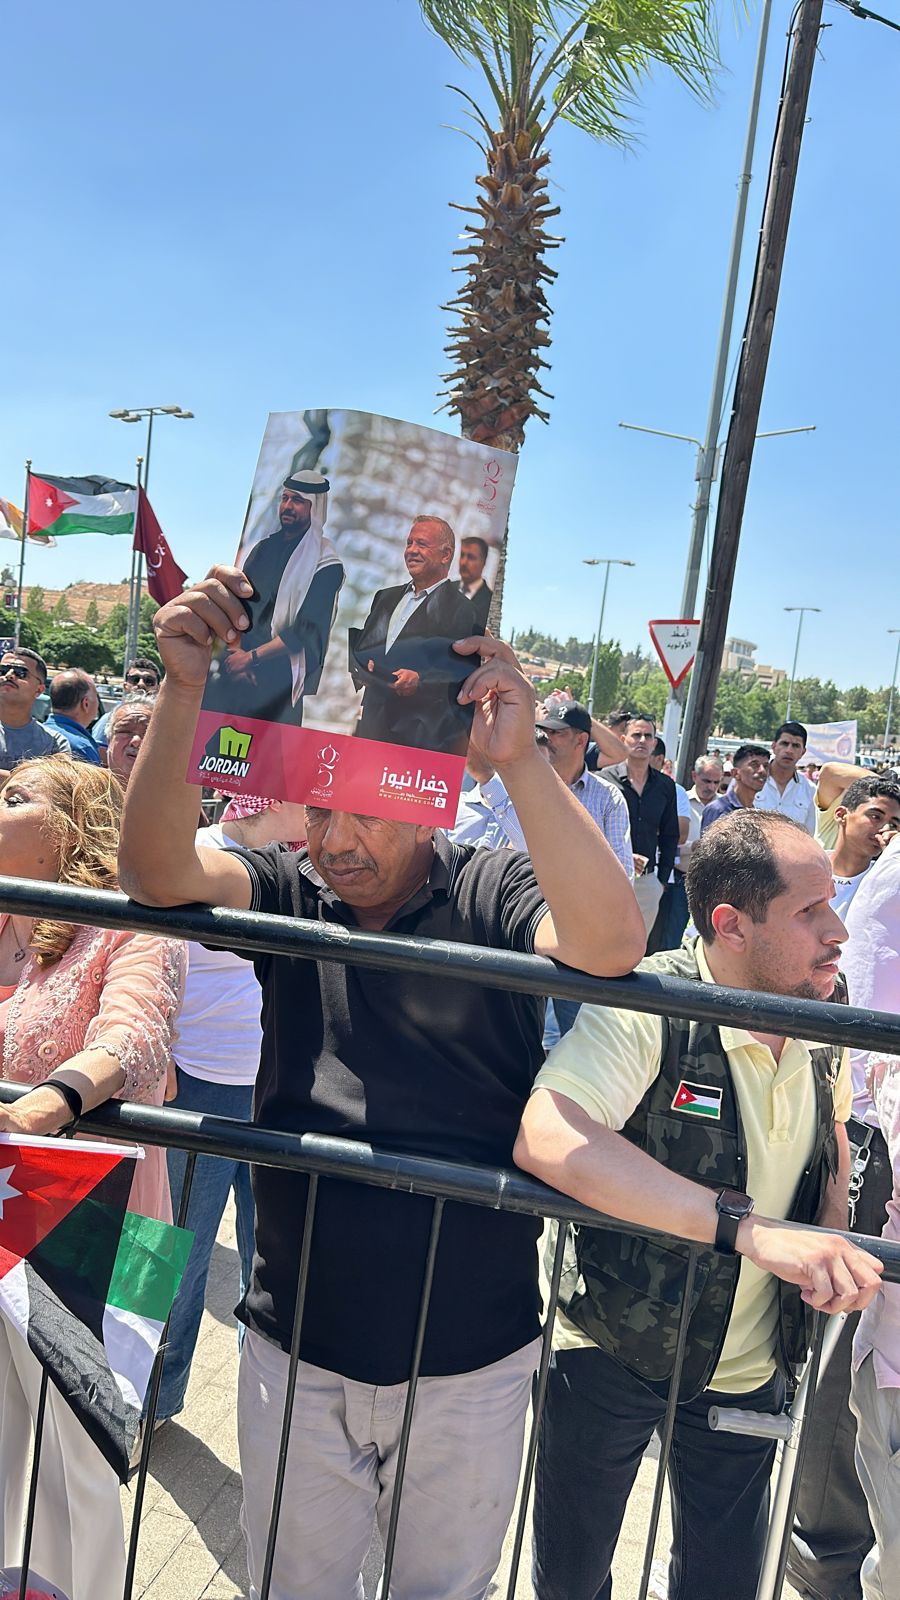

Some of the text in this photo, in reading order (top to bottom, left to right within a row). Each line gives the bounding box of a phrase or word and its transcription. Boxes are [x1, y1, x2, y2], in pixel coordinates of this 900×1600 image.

[198, 755, 251, 778] JORDAN
[380, 766, 412, 790] نيوز
[415, 769, 449, 797] جفرا
